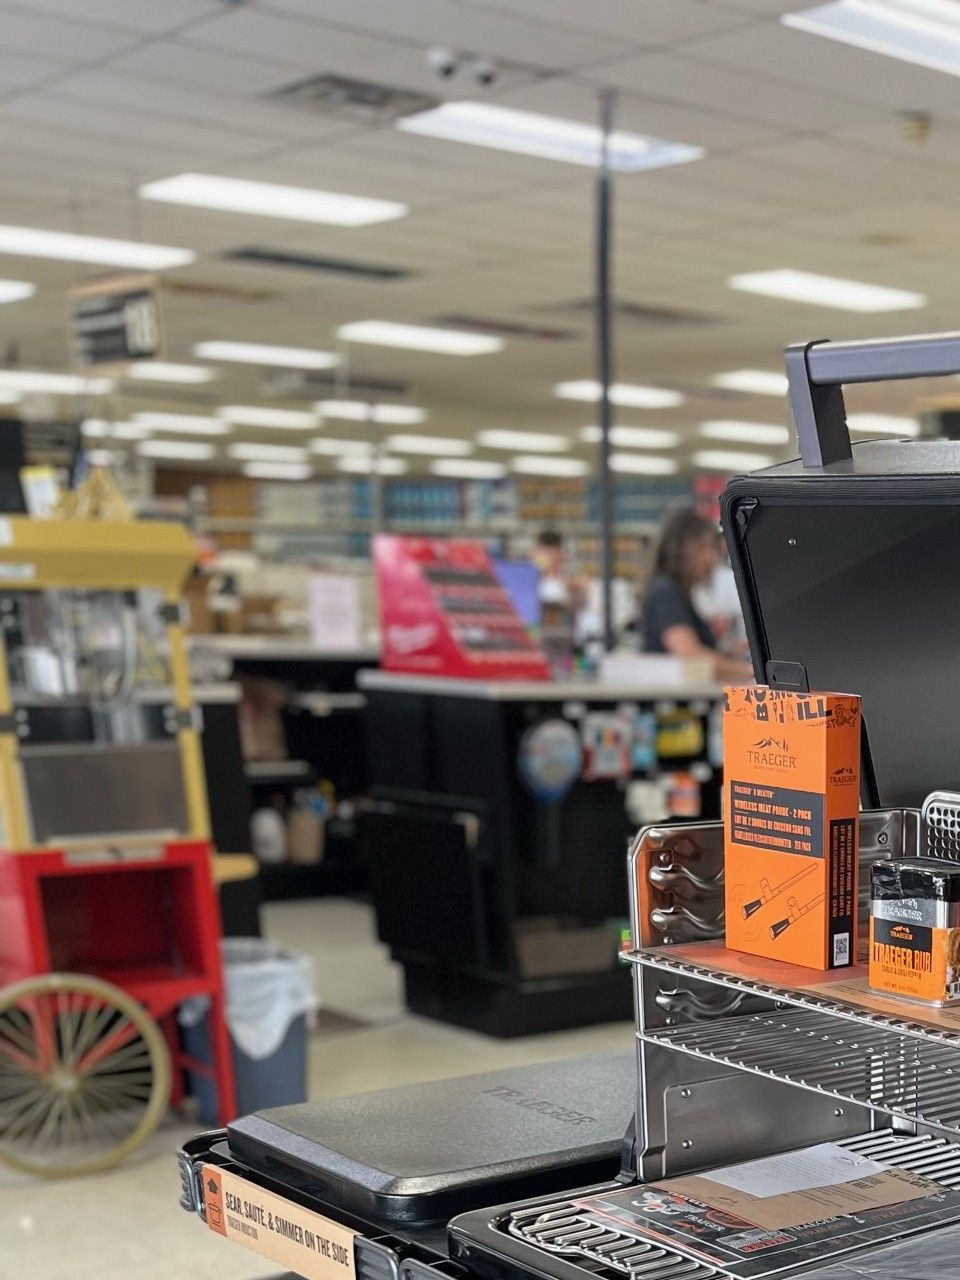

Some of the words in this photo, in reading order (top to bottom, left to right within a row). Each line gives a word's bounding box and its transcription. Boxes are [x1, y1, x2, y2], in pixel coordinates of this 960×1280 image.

[747, 751, 797, 768] TRAEGER
[889, 930, 913, 940] TRAEGER
[873, 943, 914, 968] TRAEGER
[914, 951, 932, 973] RUB
[225, 1192, 244, 1217] SEAR,
[268, 1212, 275, 1230] &
[275, 1215, 304, 1246] SIMMER
[304, 1230, 316, 1251] ON
[316, 1235, 331, 1259] THE
[332, 1244, 350, 1267] SIDE
